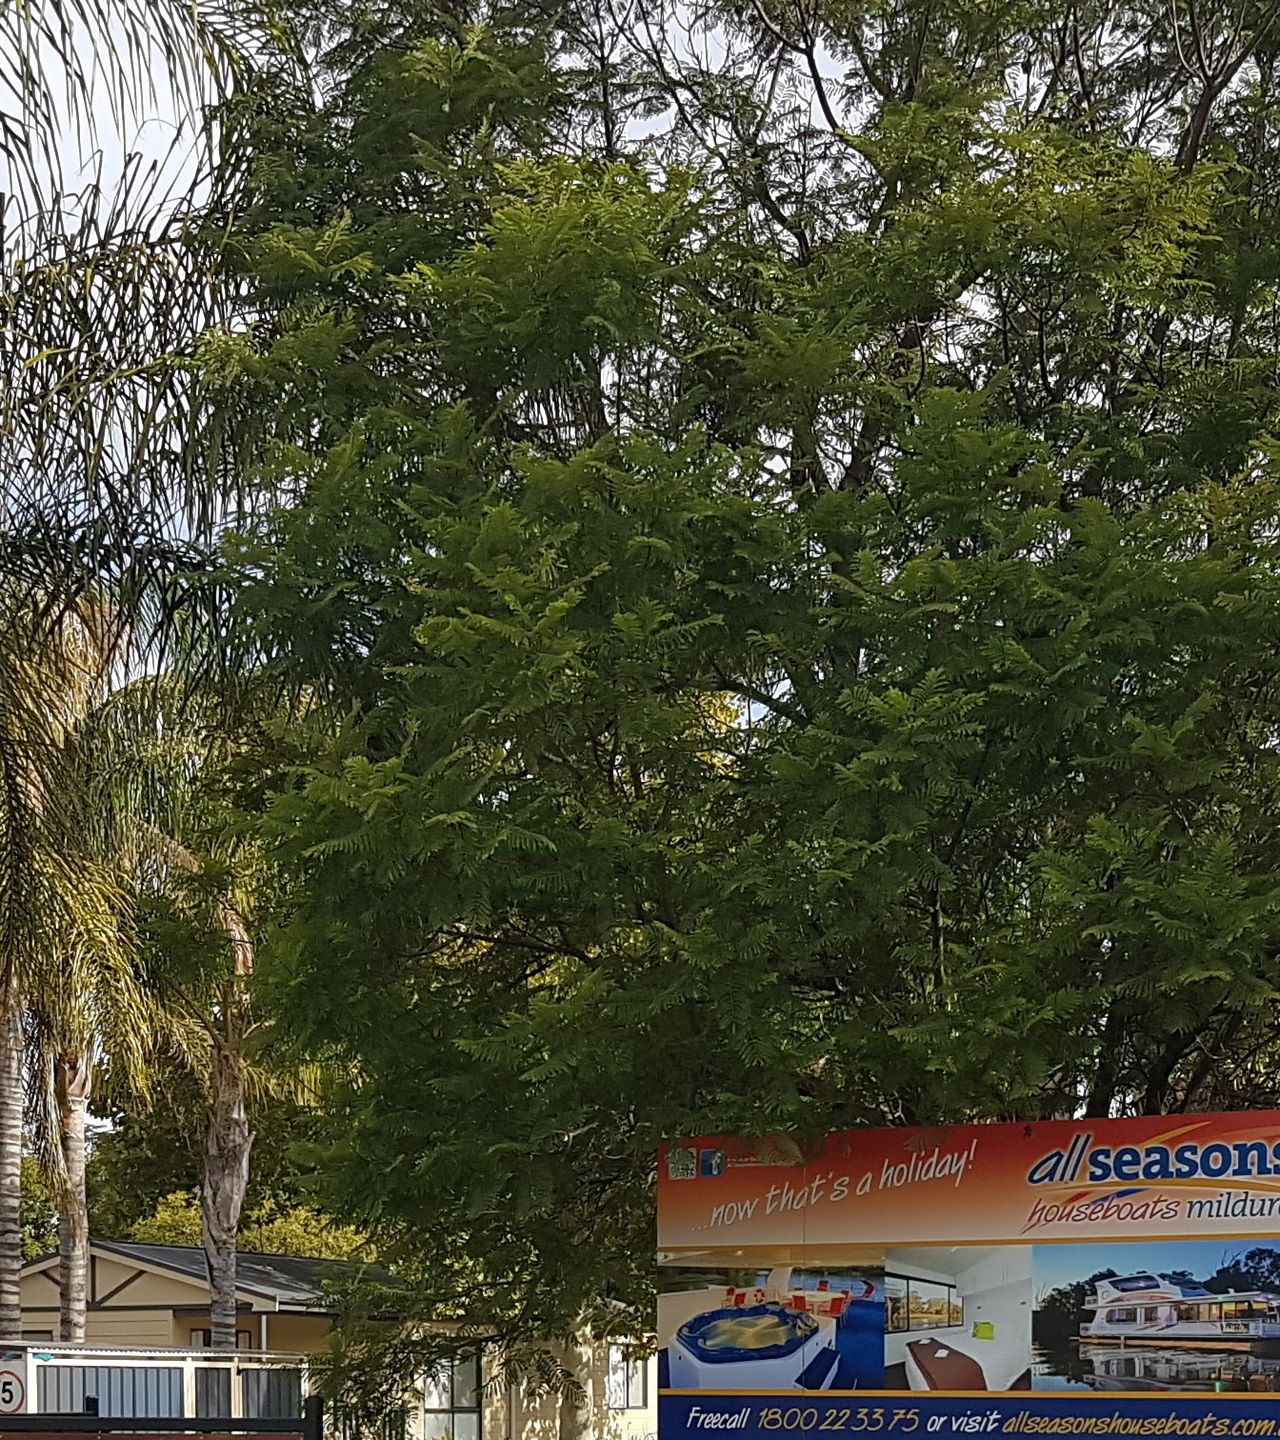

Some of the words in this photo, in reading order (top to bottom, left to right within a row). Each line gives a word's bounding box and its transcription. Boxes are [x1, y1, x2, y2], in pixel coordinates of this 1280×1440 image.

[765, 1171, 849, 1216] that's
[856, 1170, 873, 1196] a
[878, 1138, 977, 1190] holiday!
[1023, 1195, 1181, 1232] houseboats
[1, 1381, 14, 1405] 5
[686, 1406, 751, 1430] Freecall
[757, 1407, 818, 1430] 1800
[926, 1413, 945, 1432] or
[951, 1409, 1002, 1433] visit
